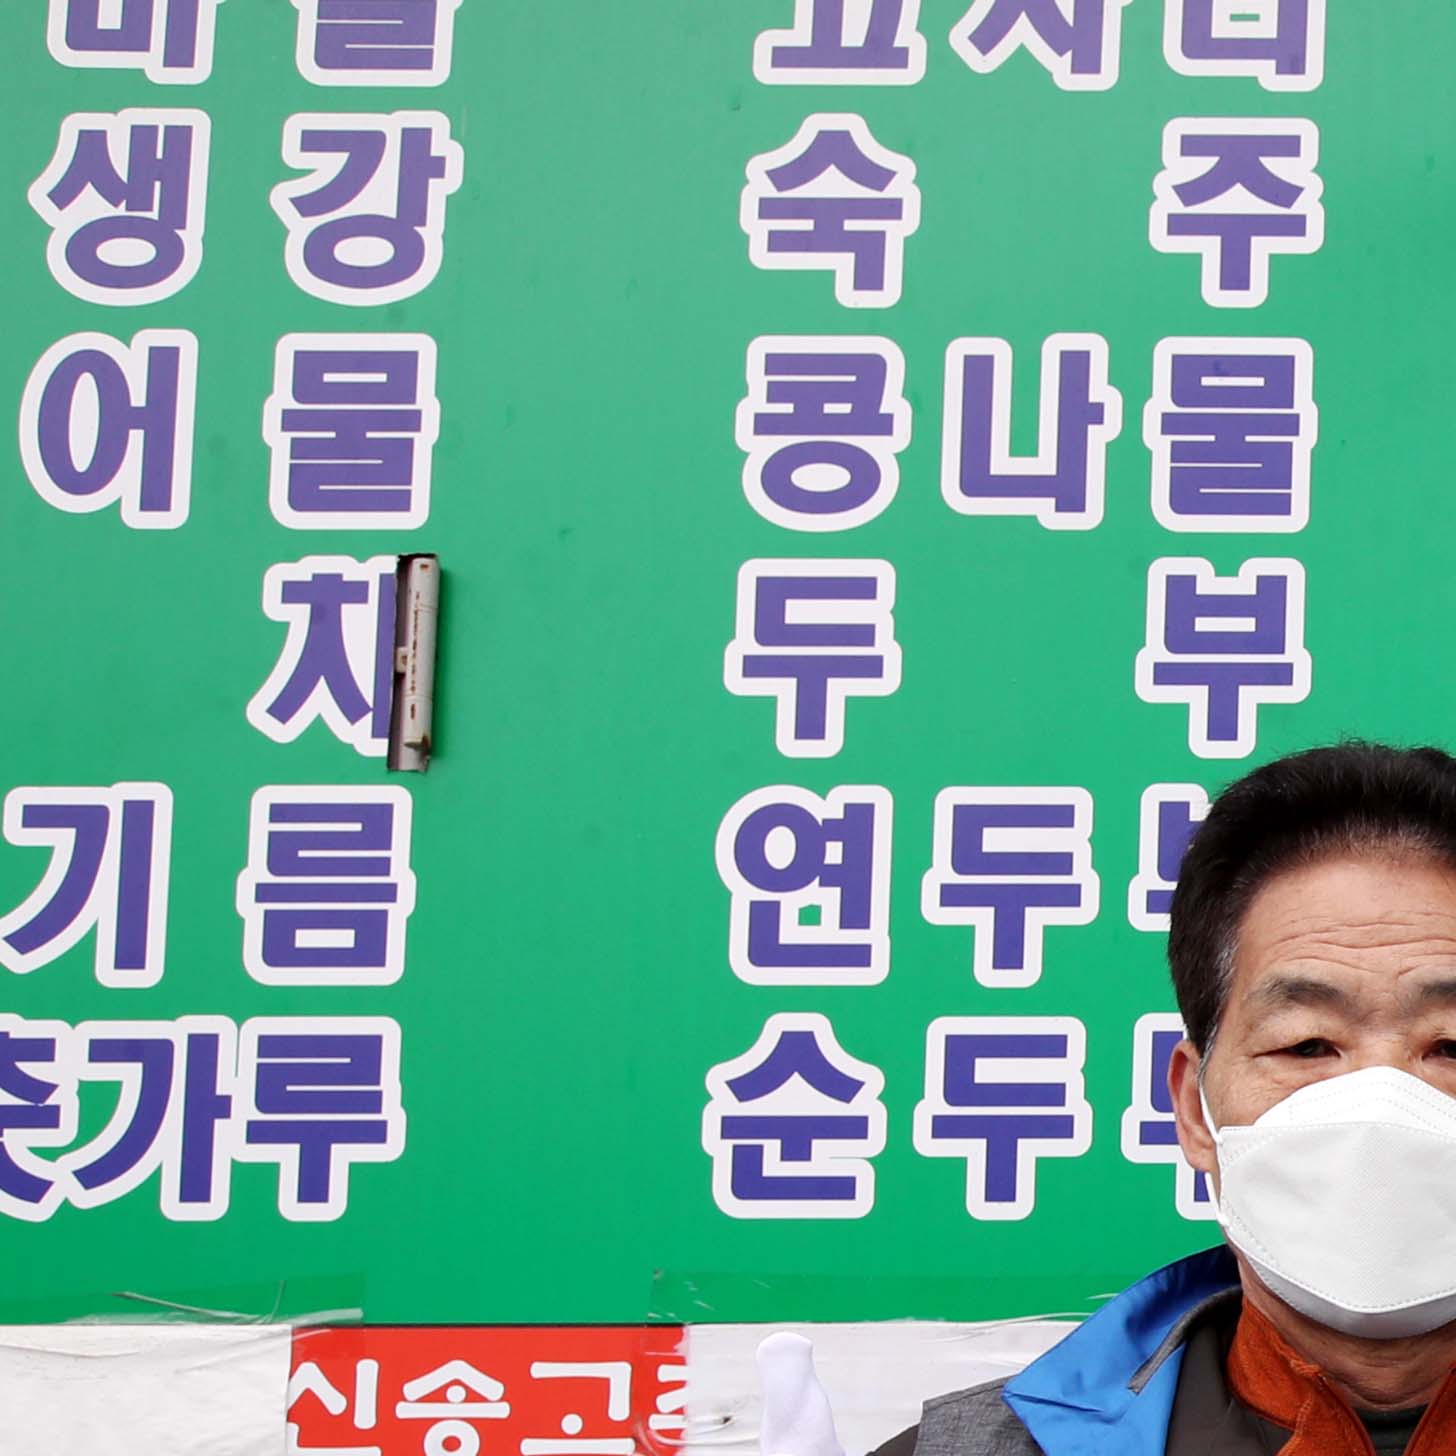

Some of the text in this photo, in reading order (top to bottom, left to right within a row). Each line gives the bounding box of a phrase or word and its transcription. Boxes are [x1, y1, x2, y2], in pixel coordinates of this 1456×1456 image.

[30, 110, 460, 303] 생강
[742, 115, 1322, 306] 숙주
[22, 330, 438, 527] 어물
[737, 335, 1318, 531] 콩나물
[726, 560, 1310, 757] 두부
[0, 785, 415, 985] 기름
